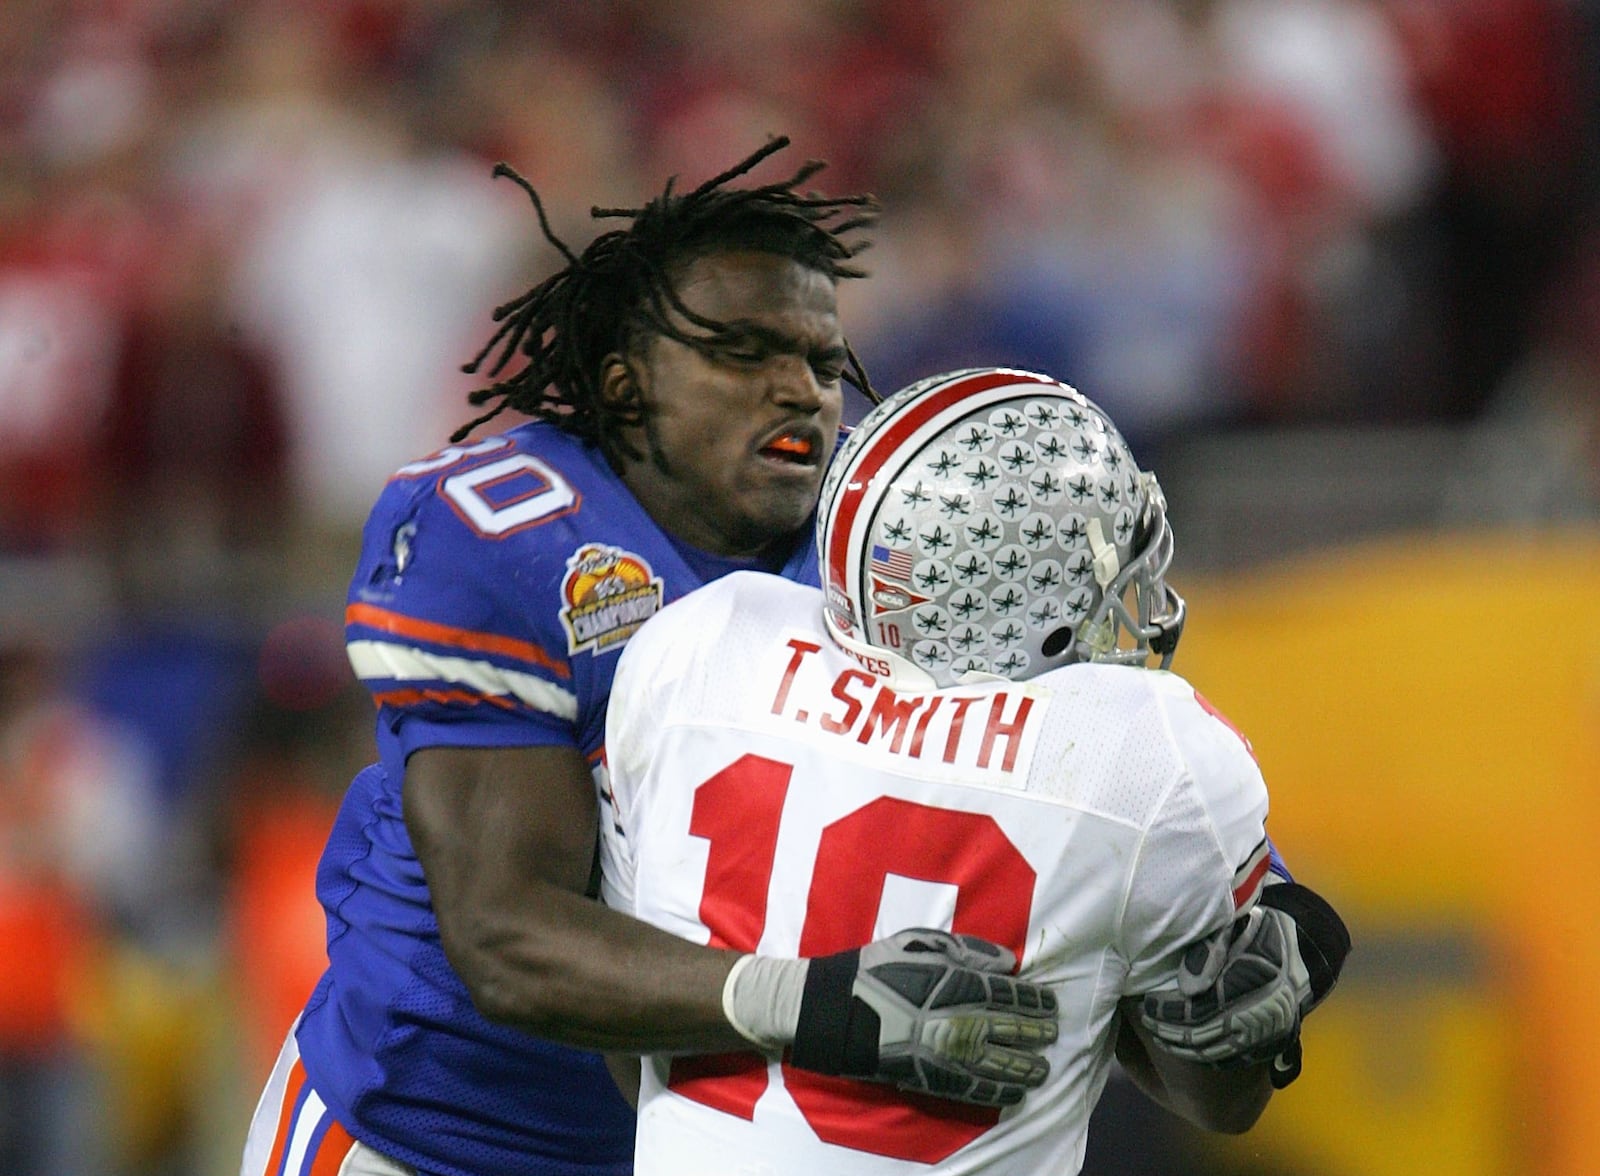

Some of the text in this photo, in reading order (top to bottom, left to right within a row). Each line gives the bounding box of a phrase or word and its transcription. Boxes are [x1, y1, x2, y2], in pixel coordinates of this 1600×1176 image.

[878, 621, 901, 649] 10
[771, 638, 1036, 773] T.SMITH
[668, 752, 1037, 1166] 10
